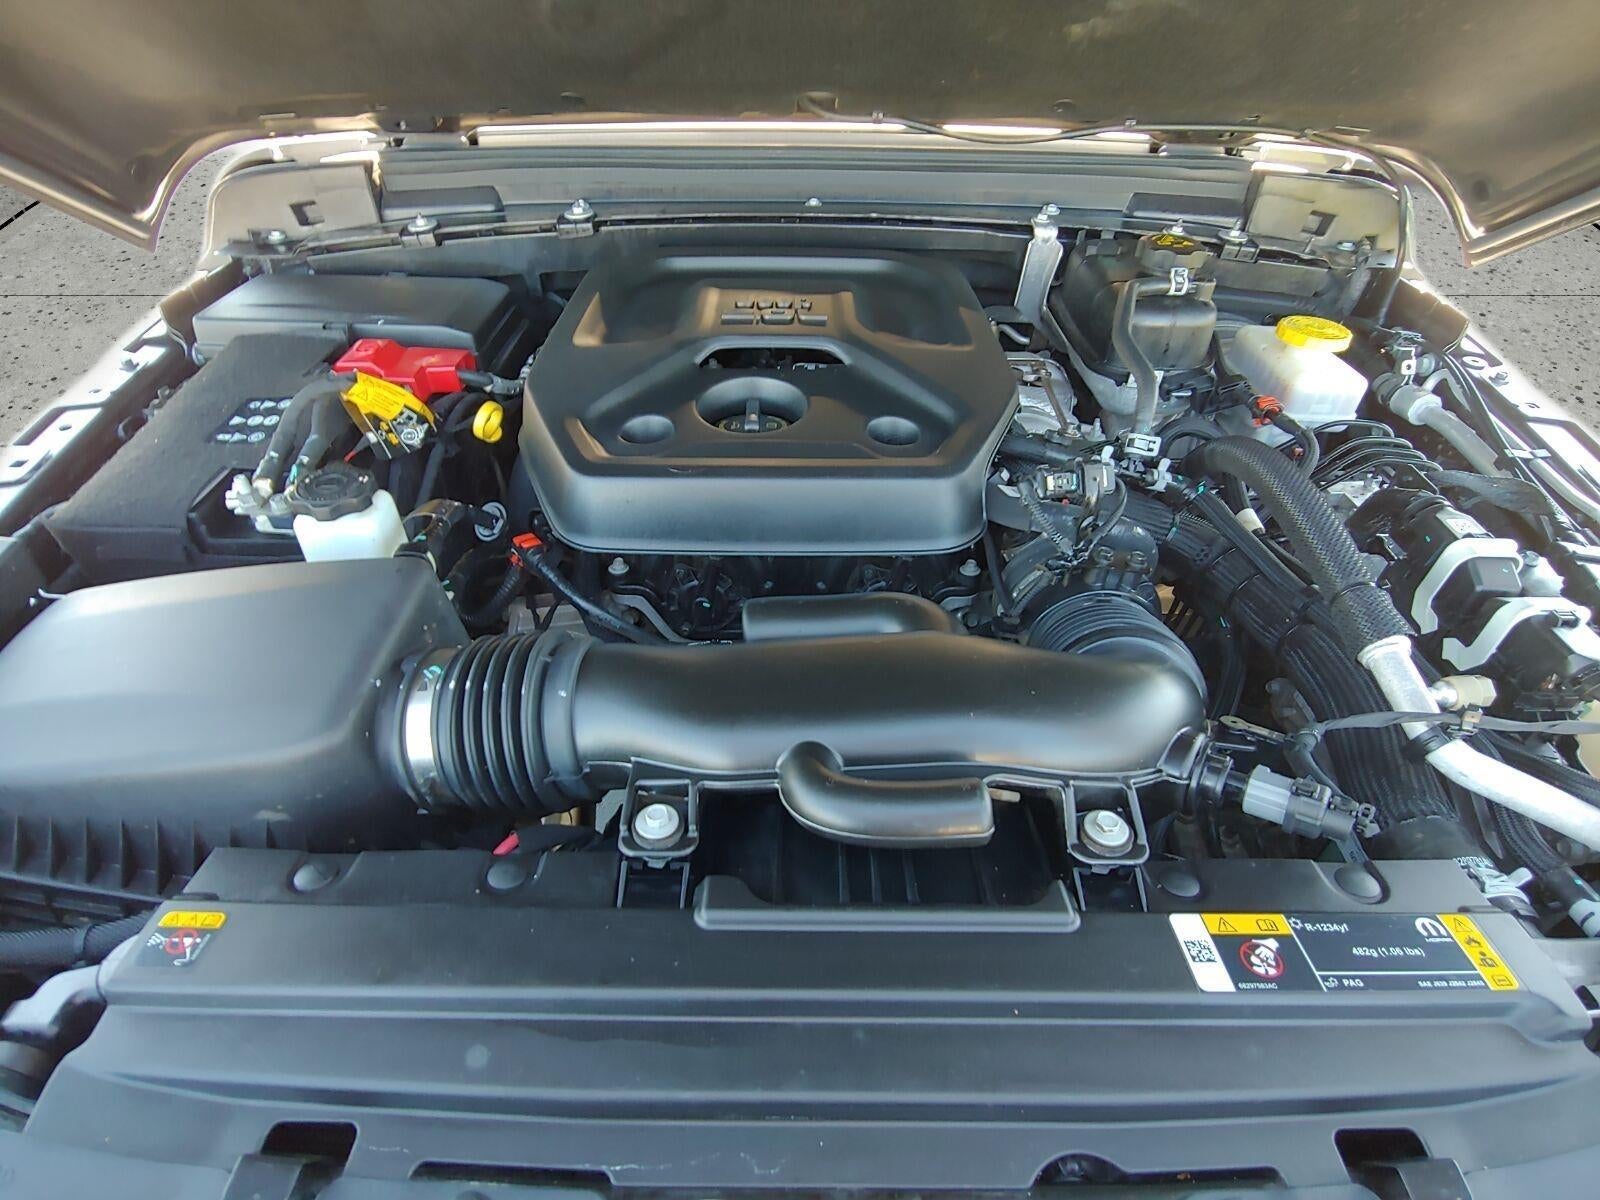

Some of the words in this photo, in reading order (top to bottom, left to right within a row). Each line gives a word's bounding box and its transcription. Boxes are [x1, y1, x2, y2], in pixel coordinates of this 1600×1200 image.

[1352, 946, 1378, 957] 482g
[1403, 946, 1426, 957] lbs)
[1342, 978, 1364, 987] PAG
